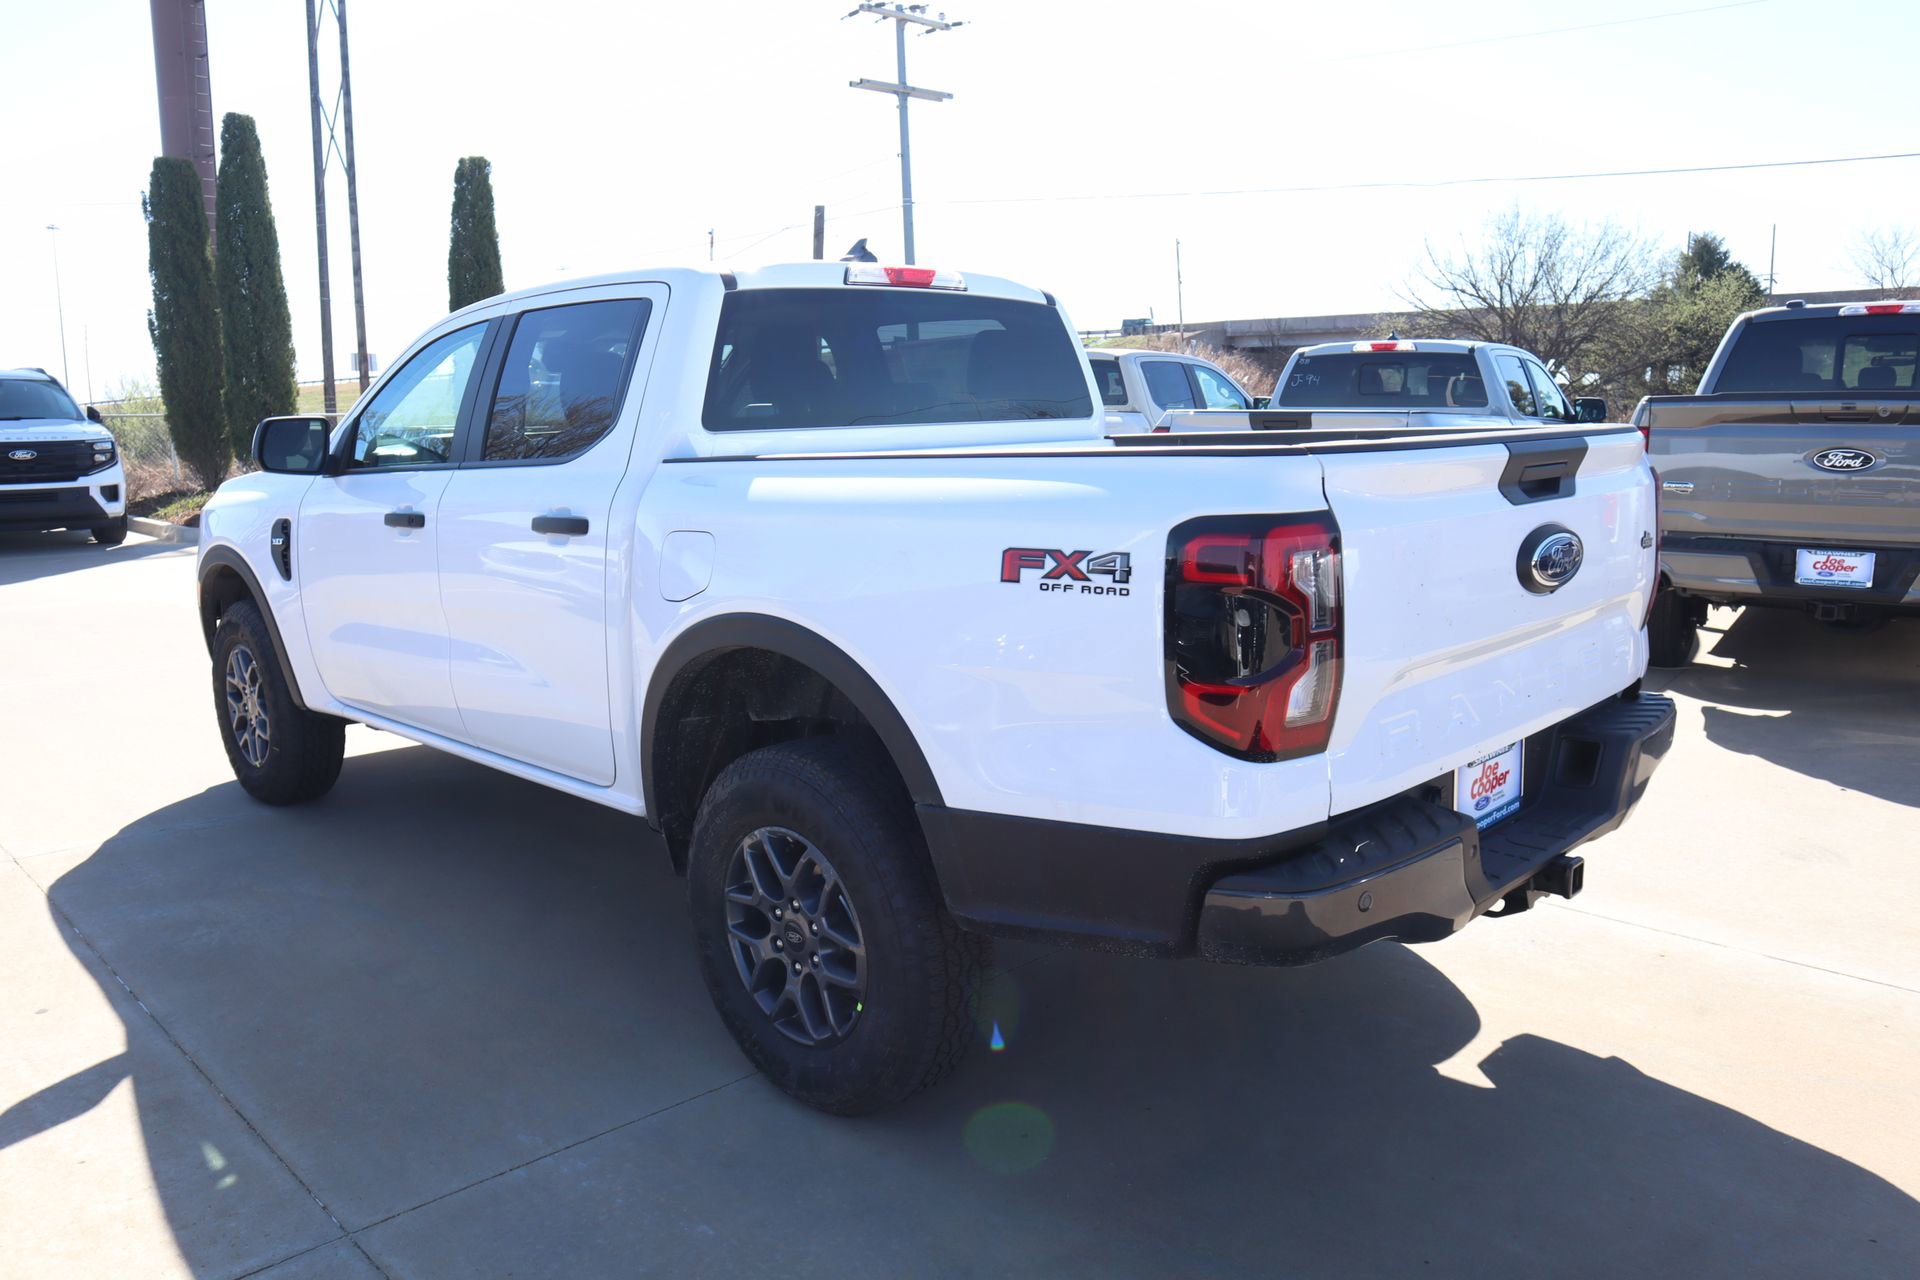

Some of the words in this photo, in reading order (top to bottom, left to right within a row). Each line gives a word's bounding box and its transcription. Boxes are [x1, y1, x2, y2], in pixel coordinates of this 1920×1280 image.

[1824, 452, 1865, 467] Ford
[1000, 547, 1132, 584] FX4
[1812, 560, 1858, 572] Cooper
[1824, 554, 1845, 565] Joe
[1039, 583, 1074, 593] OFF
[1081, 585, 1130, 597] ROAD
[1480, 761, 1500, 780] Joe
[1470, 769, 1510, 799] Cooper
